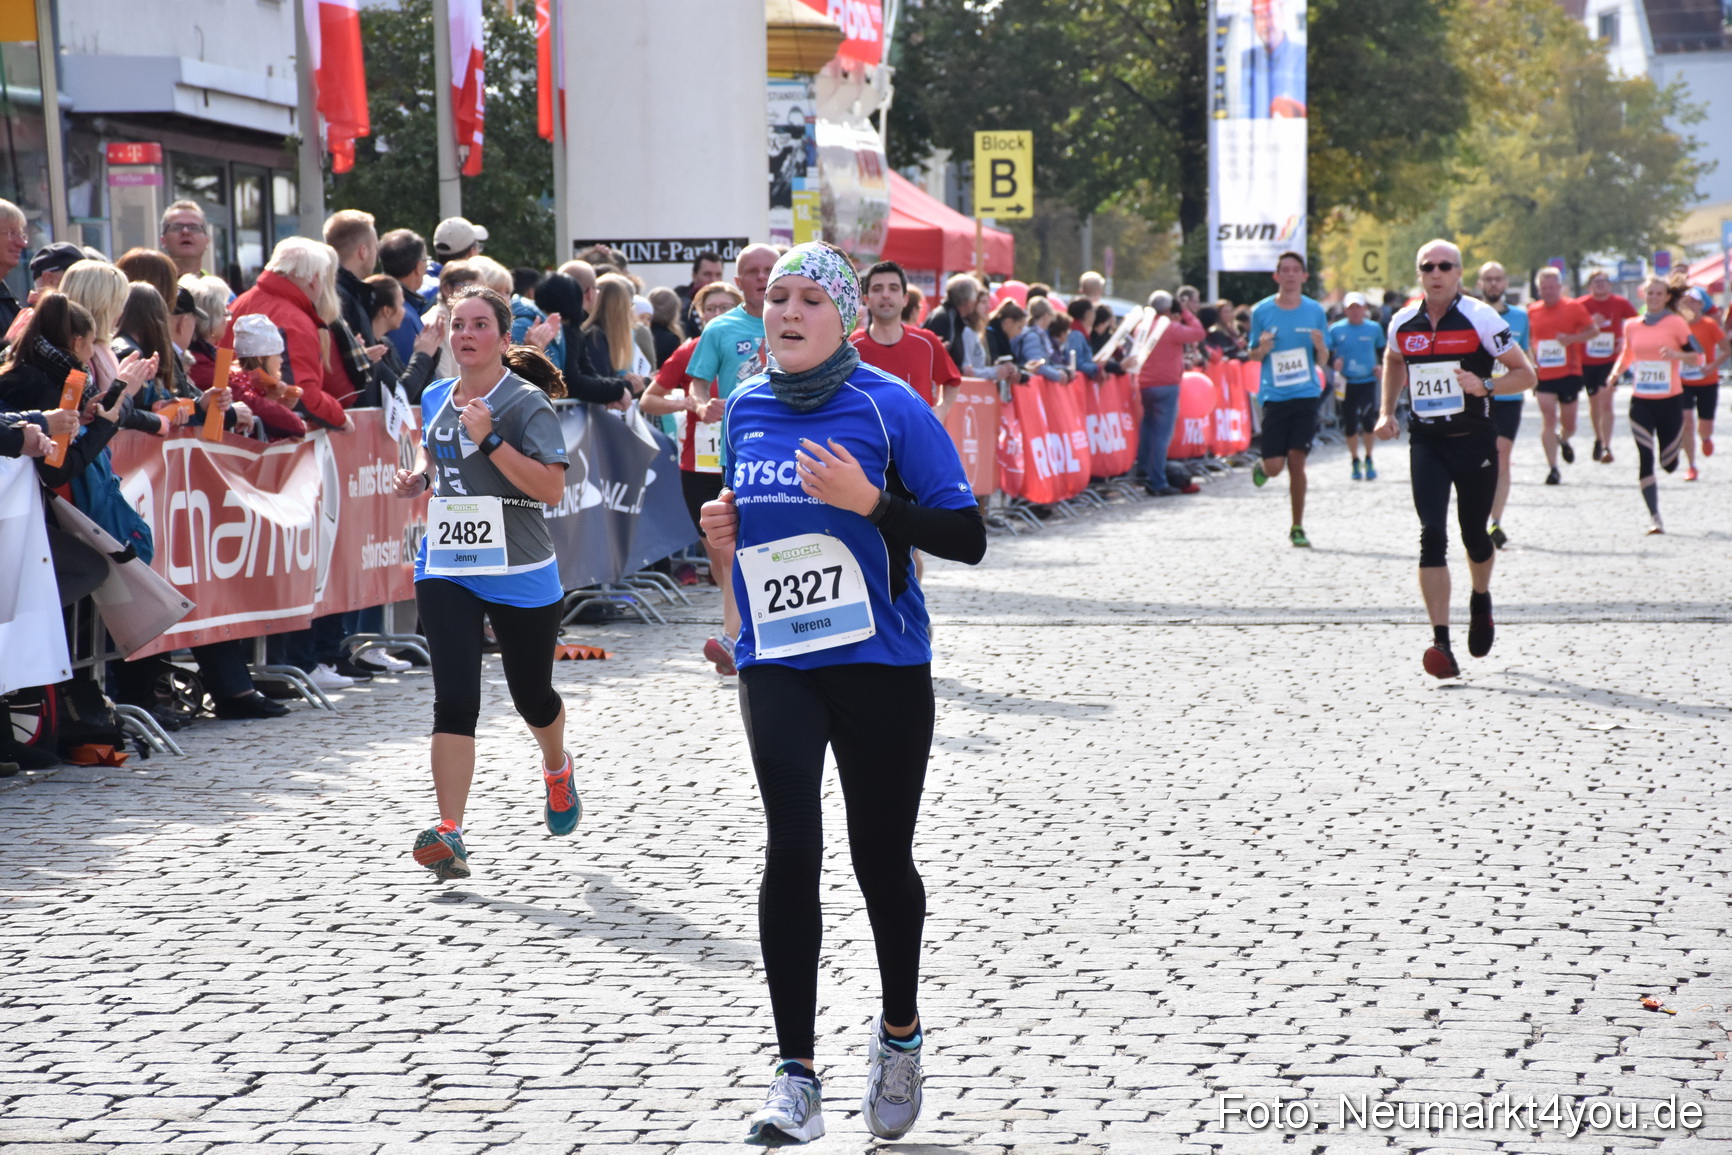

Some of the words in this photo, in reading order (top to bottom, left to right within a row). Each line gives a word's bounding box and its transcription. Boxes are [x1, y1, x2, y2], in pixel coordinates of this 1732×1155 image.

[982, 135, 1025, 151] Block
[991, 159, 1017, 198] B
[1217, 223, 1277, 241] swn
[1362, 251, 1379, 274] C
[736, 341, 751, 352] 20
[1278, 360, 1303, 373] 2444
[1640, 370, 1666, 382] 2716
[1417, 379, 1451, 396] 2141
[748, 431, 764, 439] JAKO
[438, 521, 493, 545] 2482
[454, 553, 478, 563] Jenny
[782, 543, 821, 561] BOCK
[764, 565, 842, 614] 2327
[791, 618, 831, 634] Verena
